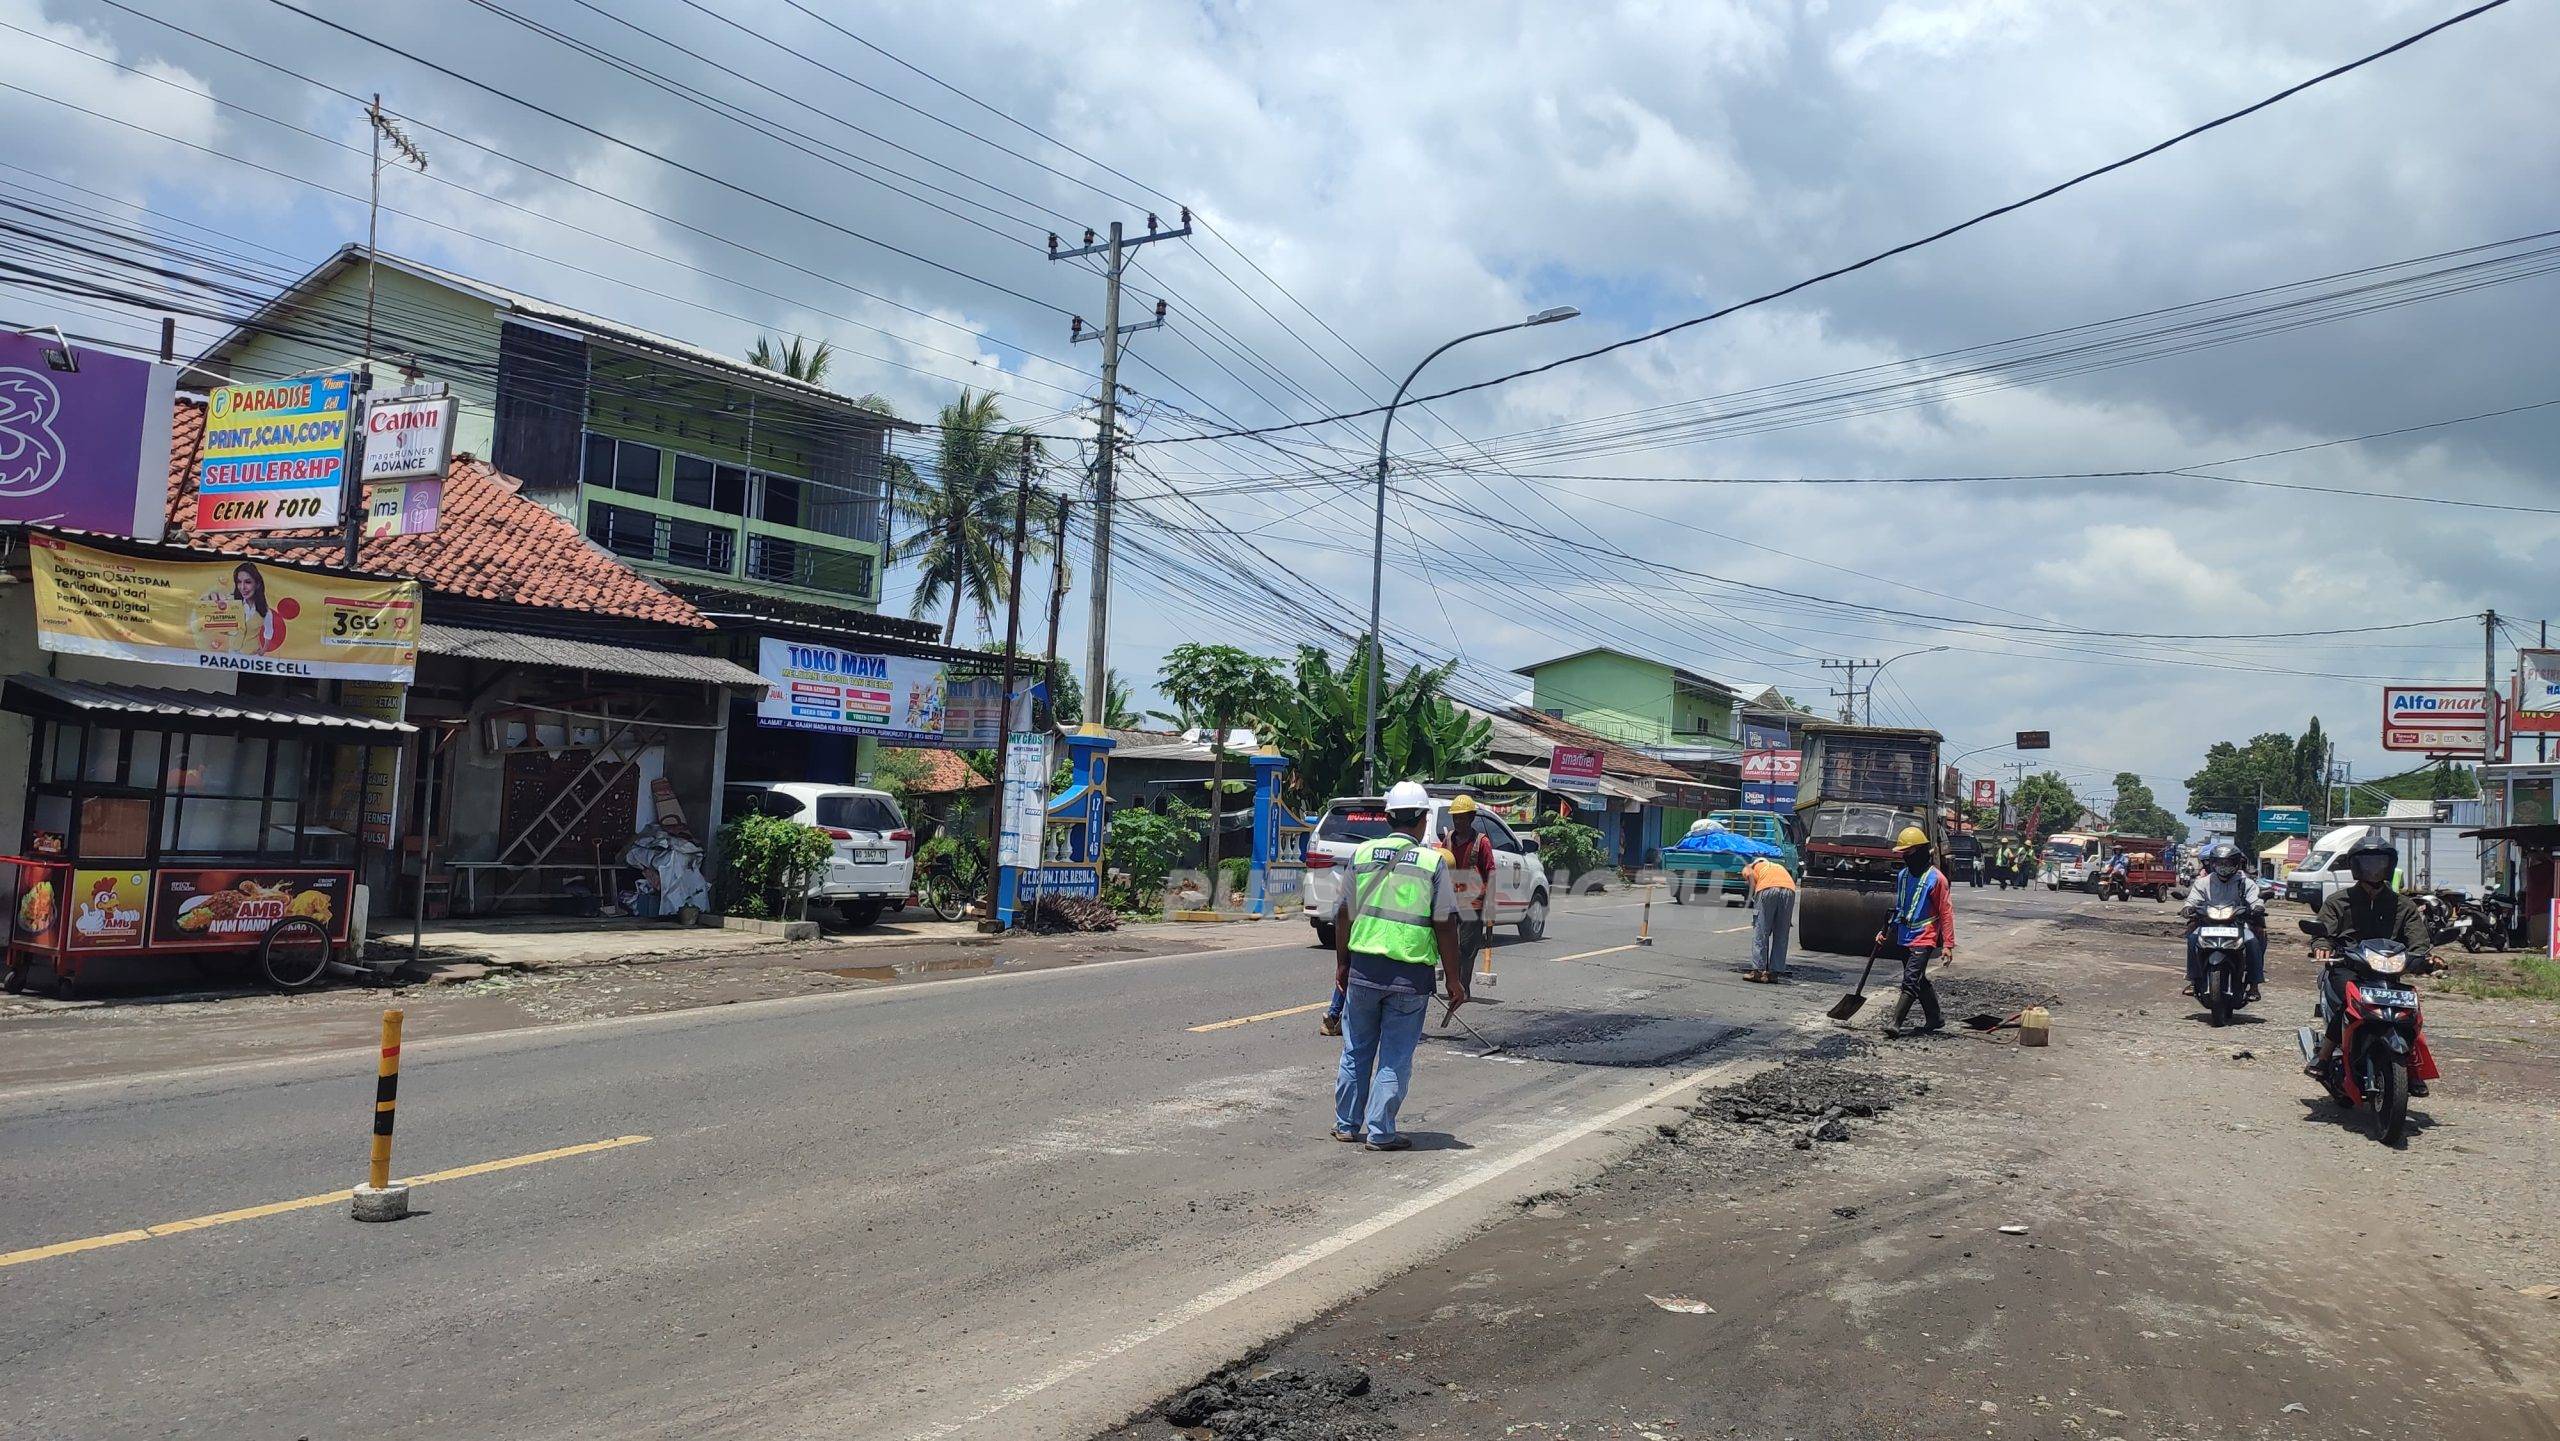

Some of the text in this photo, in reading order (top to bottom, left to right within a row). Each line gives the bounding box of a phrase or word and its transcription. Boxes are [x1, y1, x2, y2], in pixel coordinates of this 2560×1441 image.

[232, 384, 312, 412] PARADISE
[370, 409, 438, 433] Canon
[207, 419, 344, 449] PRINT,SCAN,COPY
[367, 447, 434, 461] imageRUNNER
[205, 457, 340, 486] SELULER&HP
[373, 458, 426, 473] ADVANCE
[213, 497, 321, 521] CETAK FOTO
[54, 564, 171, 588] Dengan SATSPAM
[55, 578, 147, 599] Terlindungi dari
[57, 592, 150, 613] Penipuan Digital
[200, 654, 311, 675] PARADISE CELL
[787, 645, 888, 679] TOKO MAYA
[759, 718, 783, 727] ALAMAT
[1373, 848, 1416, 862] SUPEISI
[237, 901, 284, 919] AMB
[208, 919, 238, 933] AYAM
